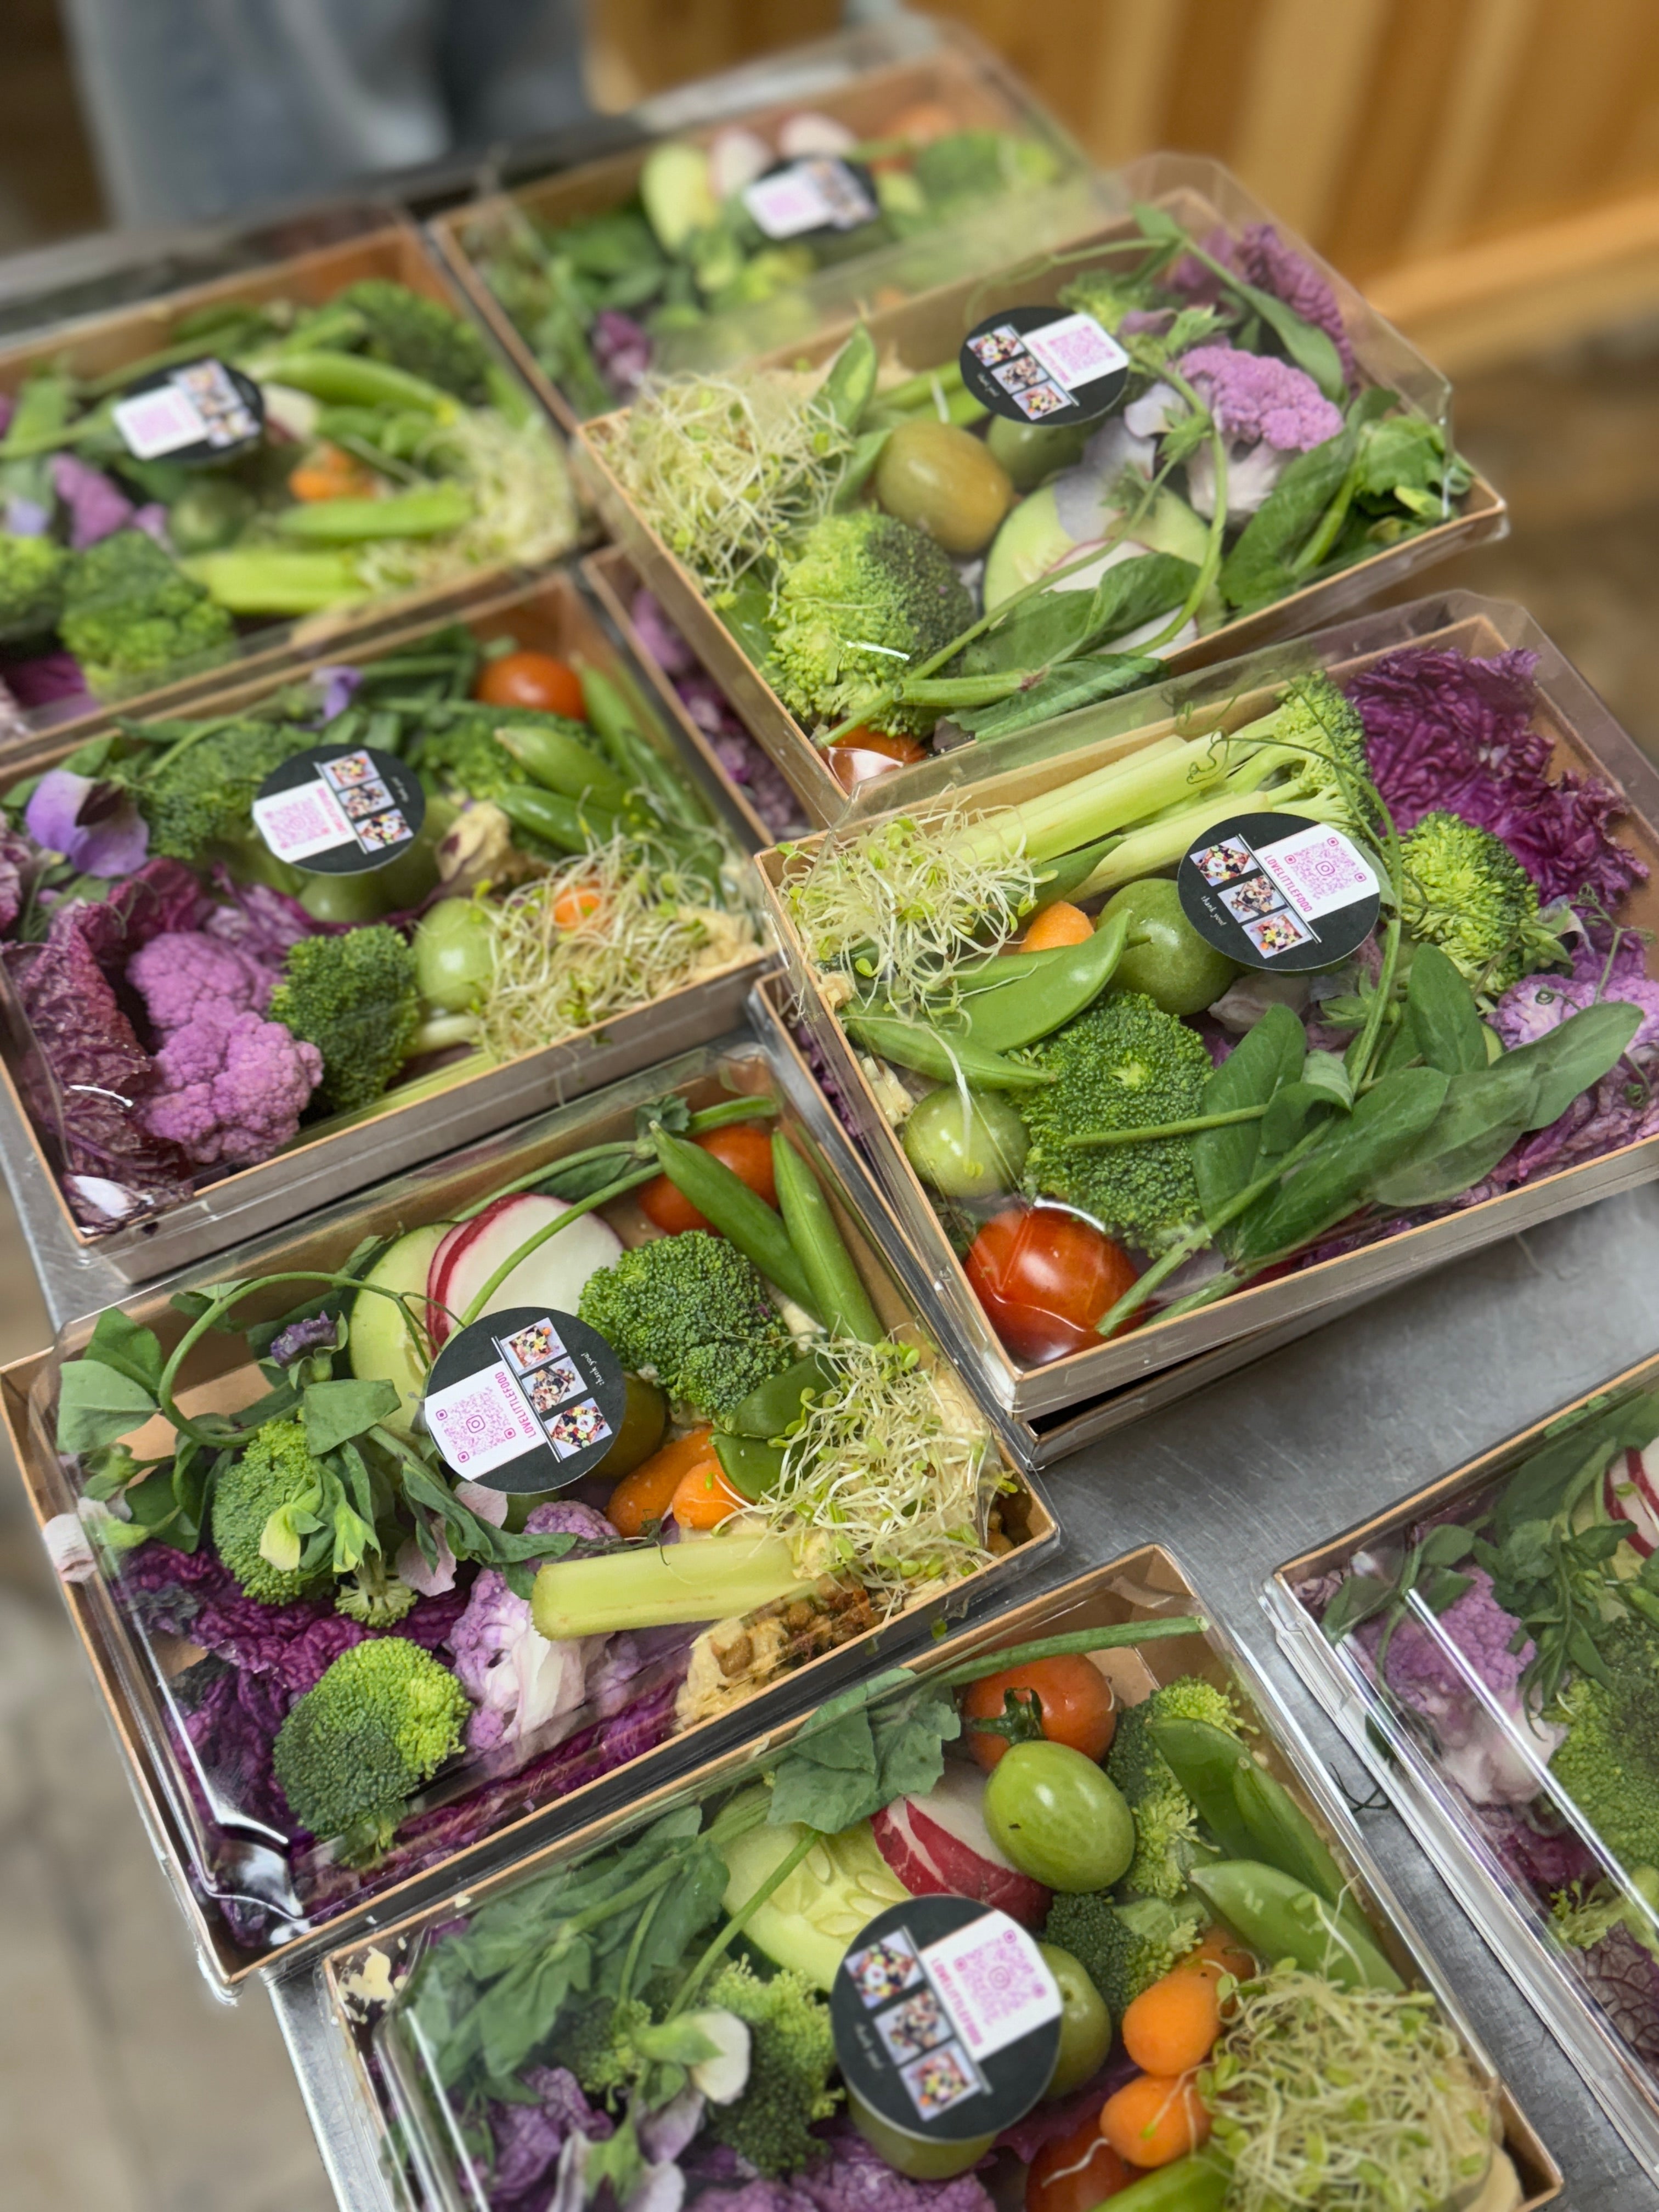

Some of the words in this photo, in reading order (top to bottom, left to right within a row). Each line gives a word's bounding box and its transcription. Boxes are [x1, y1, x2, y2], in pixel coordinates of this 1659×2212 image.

[1201, 896, 1216, 913] thank
[1265, 855, 1312, 912] LOVELITTLEFOOD
[494, 1371, 537, 1438] LOVELITTLEFOOD
